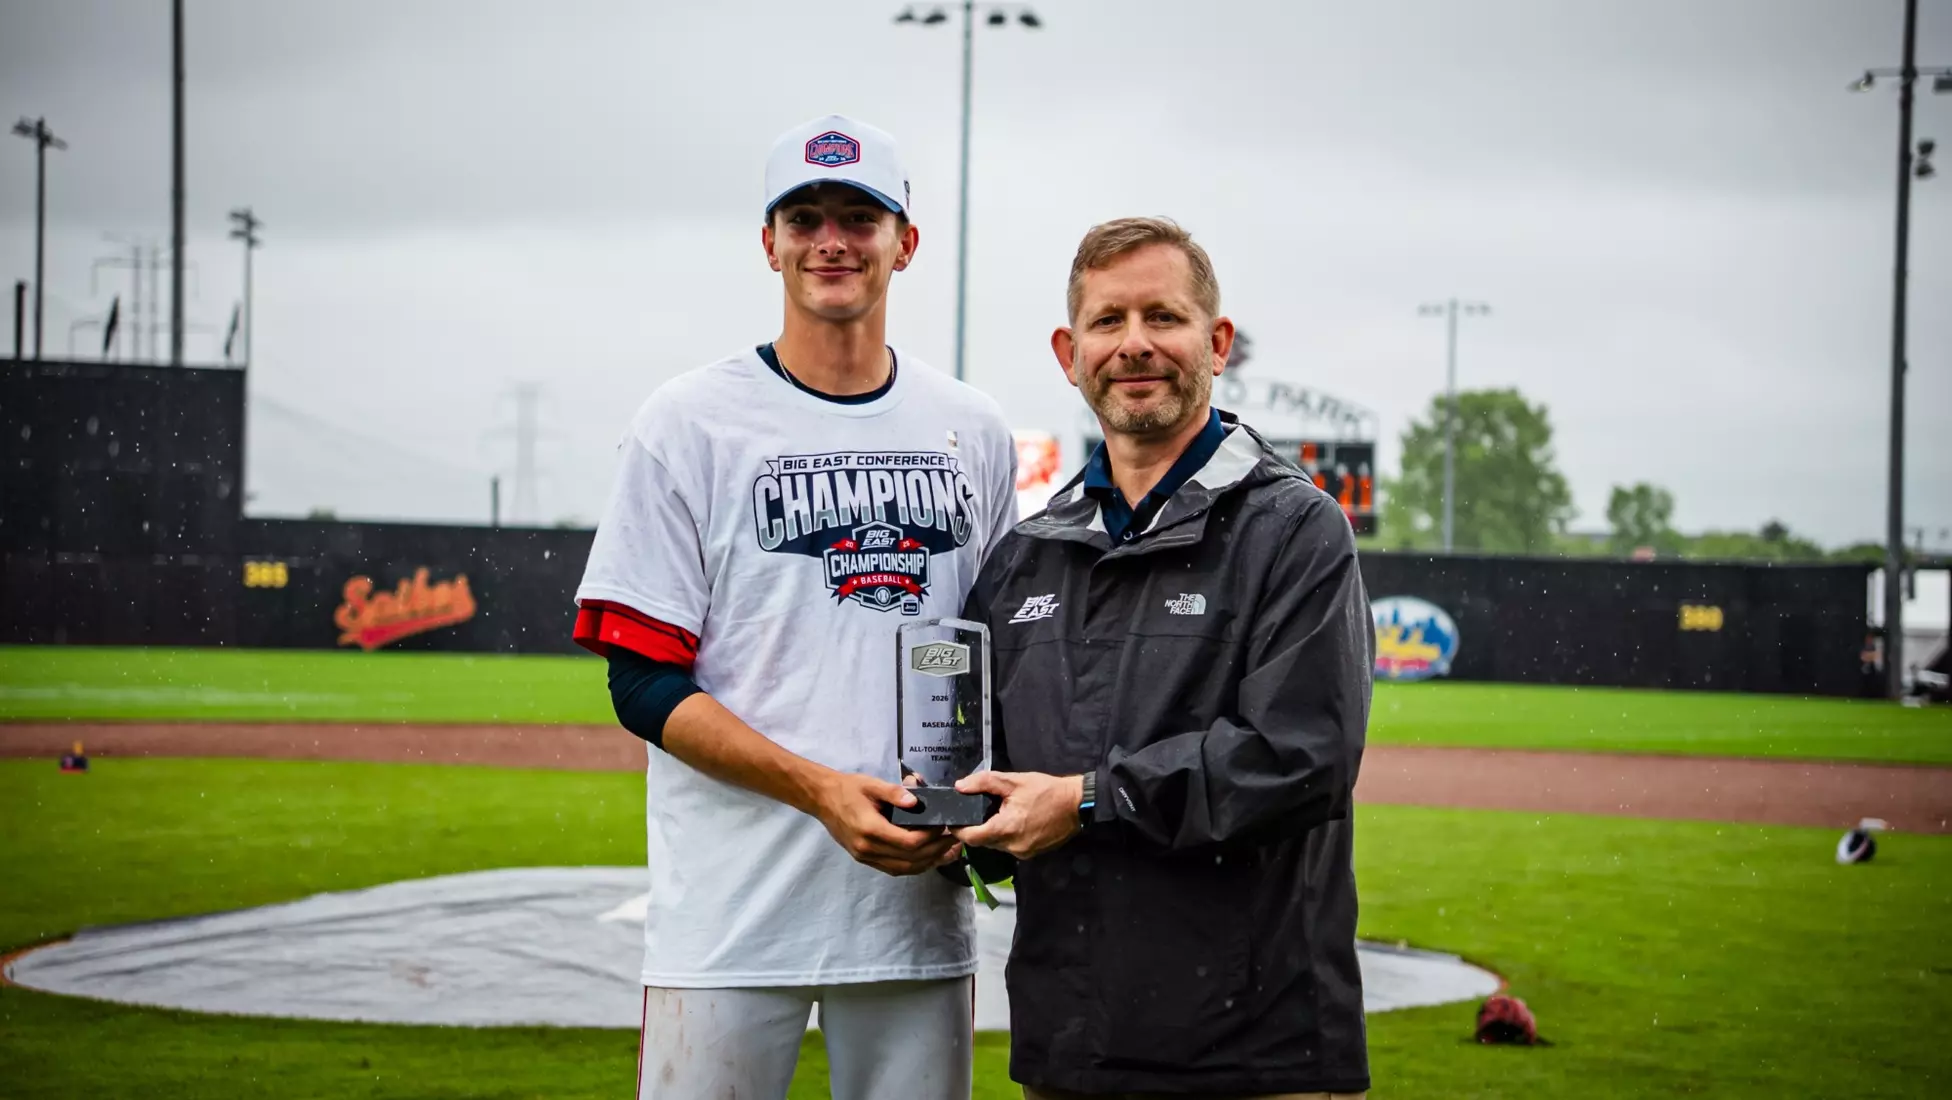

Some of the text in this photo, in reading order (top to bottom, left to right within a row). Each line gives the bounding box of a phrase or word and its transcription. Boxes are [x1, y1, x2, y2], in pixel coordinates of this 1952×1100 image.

[783, 455, 945, 470] BIG EAST CONFERENCE
[754, 470, 973, 550] CHAMPIONS
[866, 530, 891, 539] BIG
[845, 540, 854, 548] 20
[862, 538, 896, 546] EAST
[830, 553, 925, 578] CHAMPIONSHIP
[860, 575, 902, 585] BASEBALL
[1022, 593, 1056, 608] BIG
[1179, 593, 1196, 601] THE
[1164, 599, 1194, 608] NORTH
[1013, 603, 1060, 618] EAST
[1169, 607, 1192, 615] FACE
[925, 648, 955, 657] BIG
[920, 656, 962, 666] EAST
